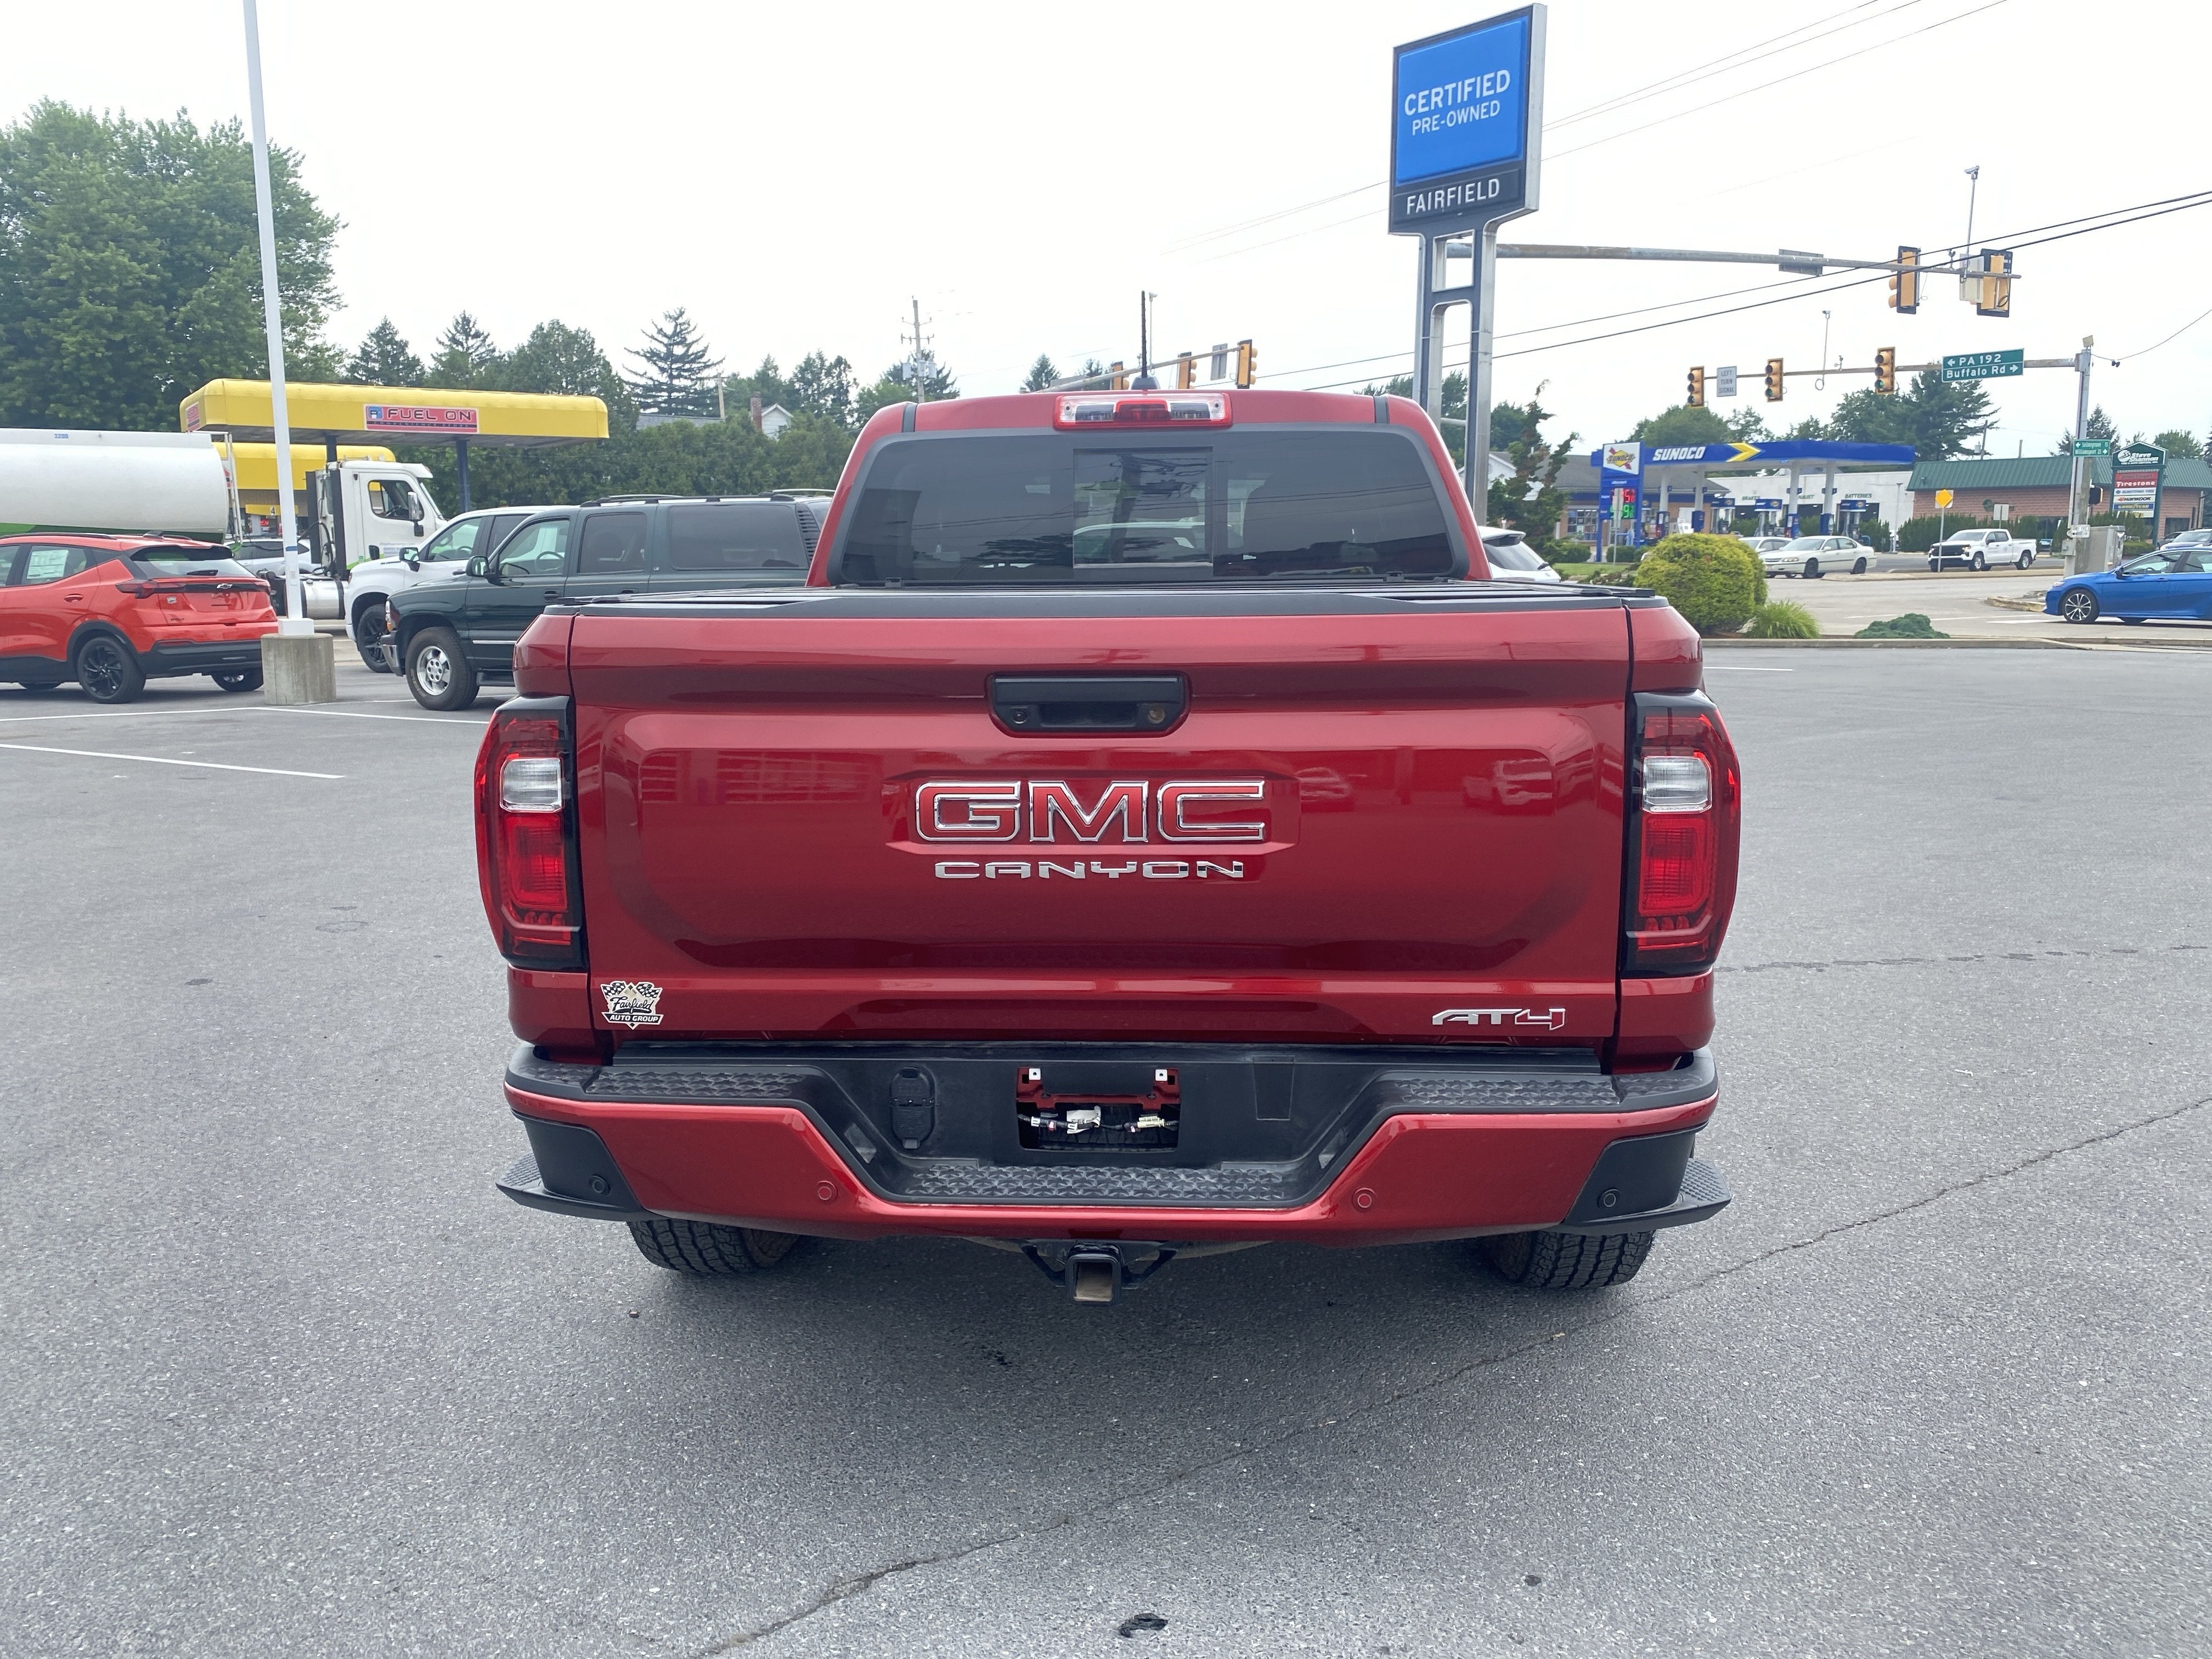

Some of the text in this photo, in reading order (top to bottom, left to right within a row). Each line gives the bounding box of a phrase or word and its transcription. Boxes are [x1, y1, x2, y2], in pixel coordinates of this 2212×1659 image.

[1404, 69, 1511, 116] CERTIFIED
[1412, 100, 1500, 136] PRE-OWNED
[1406, 178, 1500, 215] FAIRFIELD
[1959, 354, 2001, 366] PA 192
[1946, 365, 2006, 379] Buffalo Rd
[387, 409, 471, 421] FUEL ON
[1607, 455, 1634, 463] SUNOCO
[1652, 446, 1706, 461] SUNOCO
[916, 780, 1265, 842] GMC
[935, 861, 1244, 879] CANYON
[610, 996, 655, 1012] Fairfield
[1432, 1008, 1566, 1031] AT4
